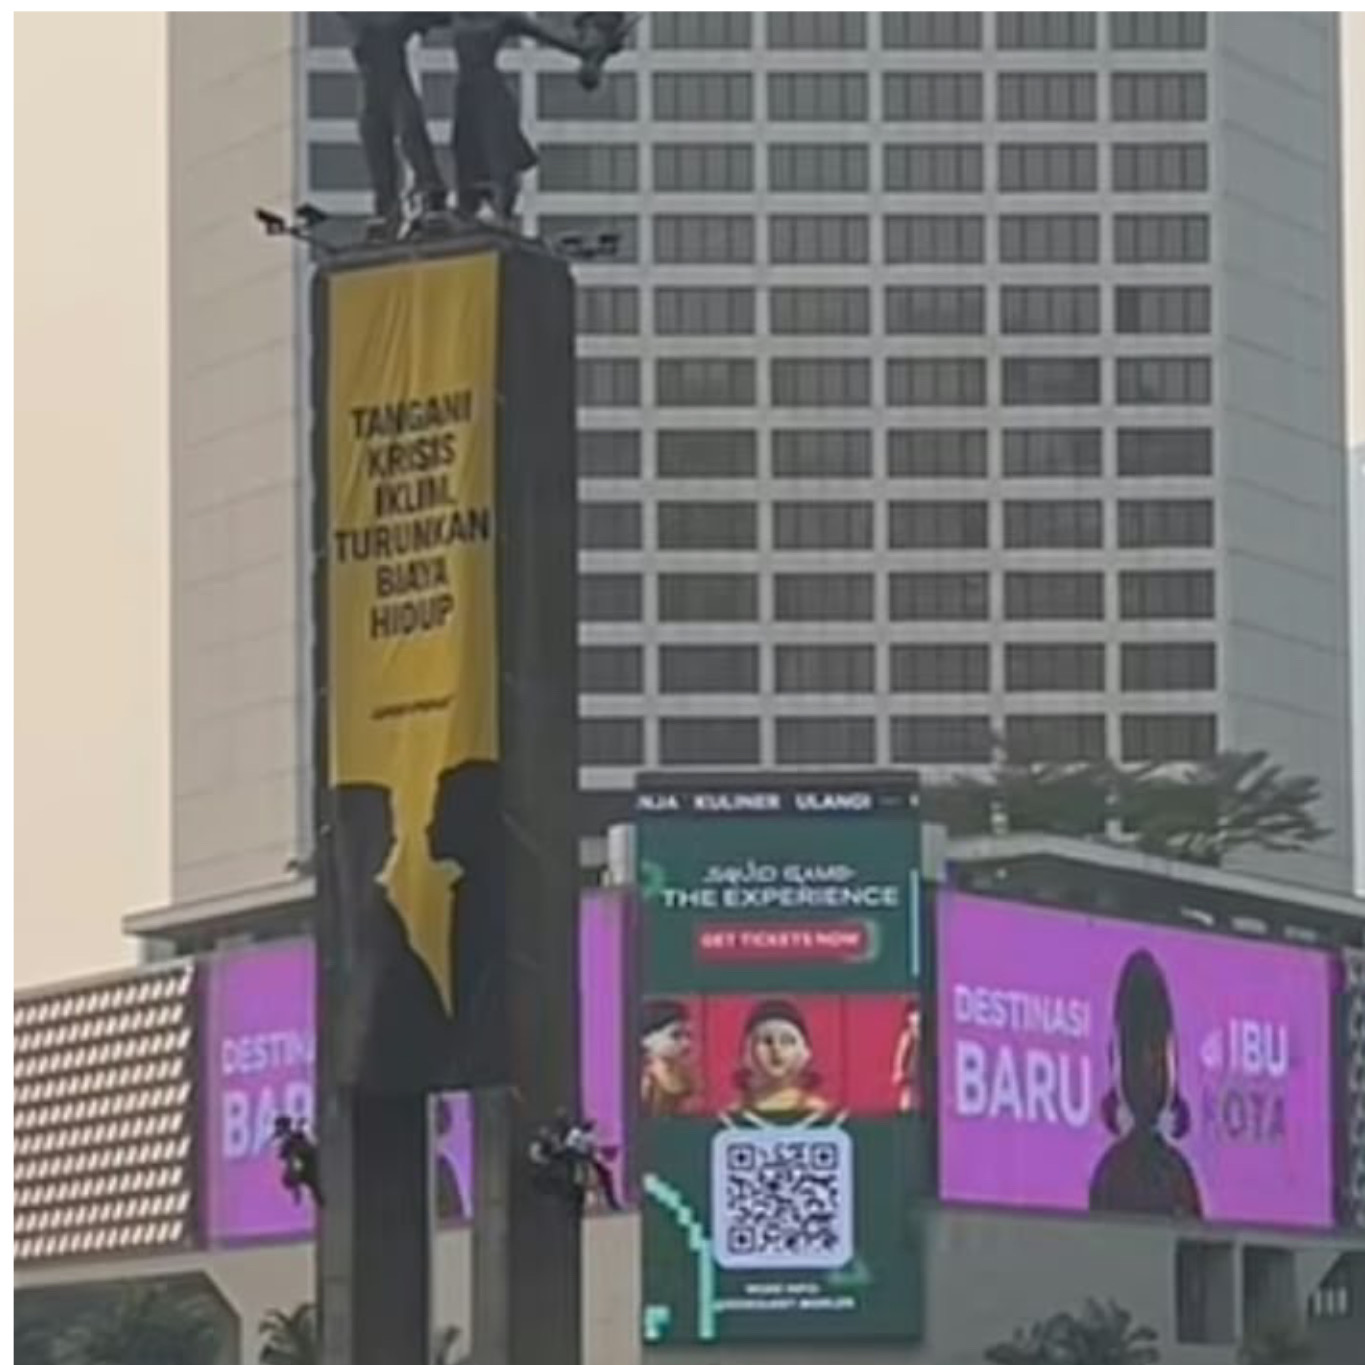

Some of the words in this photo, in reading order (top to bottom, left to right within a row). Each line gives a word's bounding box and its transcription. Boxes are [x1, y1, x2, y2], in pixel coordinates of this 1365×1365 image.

[352, 390, 472, 438] TANGANI
[367, 433, 455, 479] KRISIS
[334, 509, 489, 562] TURUNKAN
[376, 556, 450, 597] BIAYA
[370, 595, 454, 640] HIDUP
[694, 793, 781, 810] KULINER
[661, 887, 718, 908] THE
[722, 885, 900, 908] EXPERIENCE
[700, 931, 737, 948] GET
[740, 931, 813, 948] TICKETS
[815, 931, 862, 947] NOW
[954, 985, 1091, 1037] DESTINASI
[1229, 1018, 1289, 1076] IBU
[955, 1039, 1092, 1126] BARU
